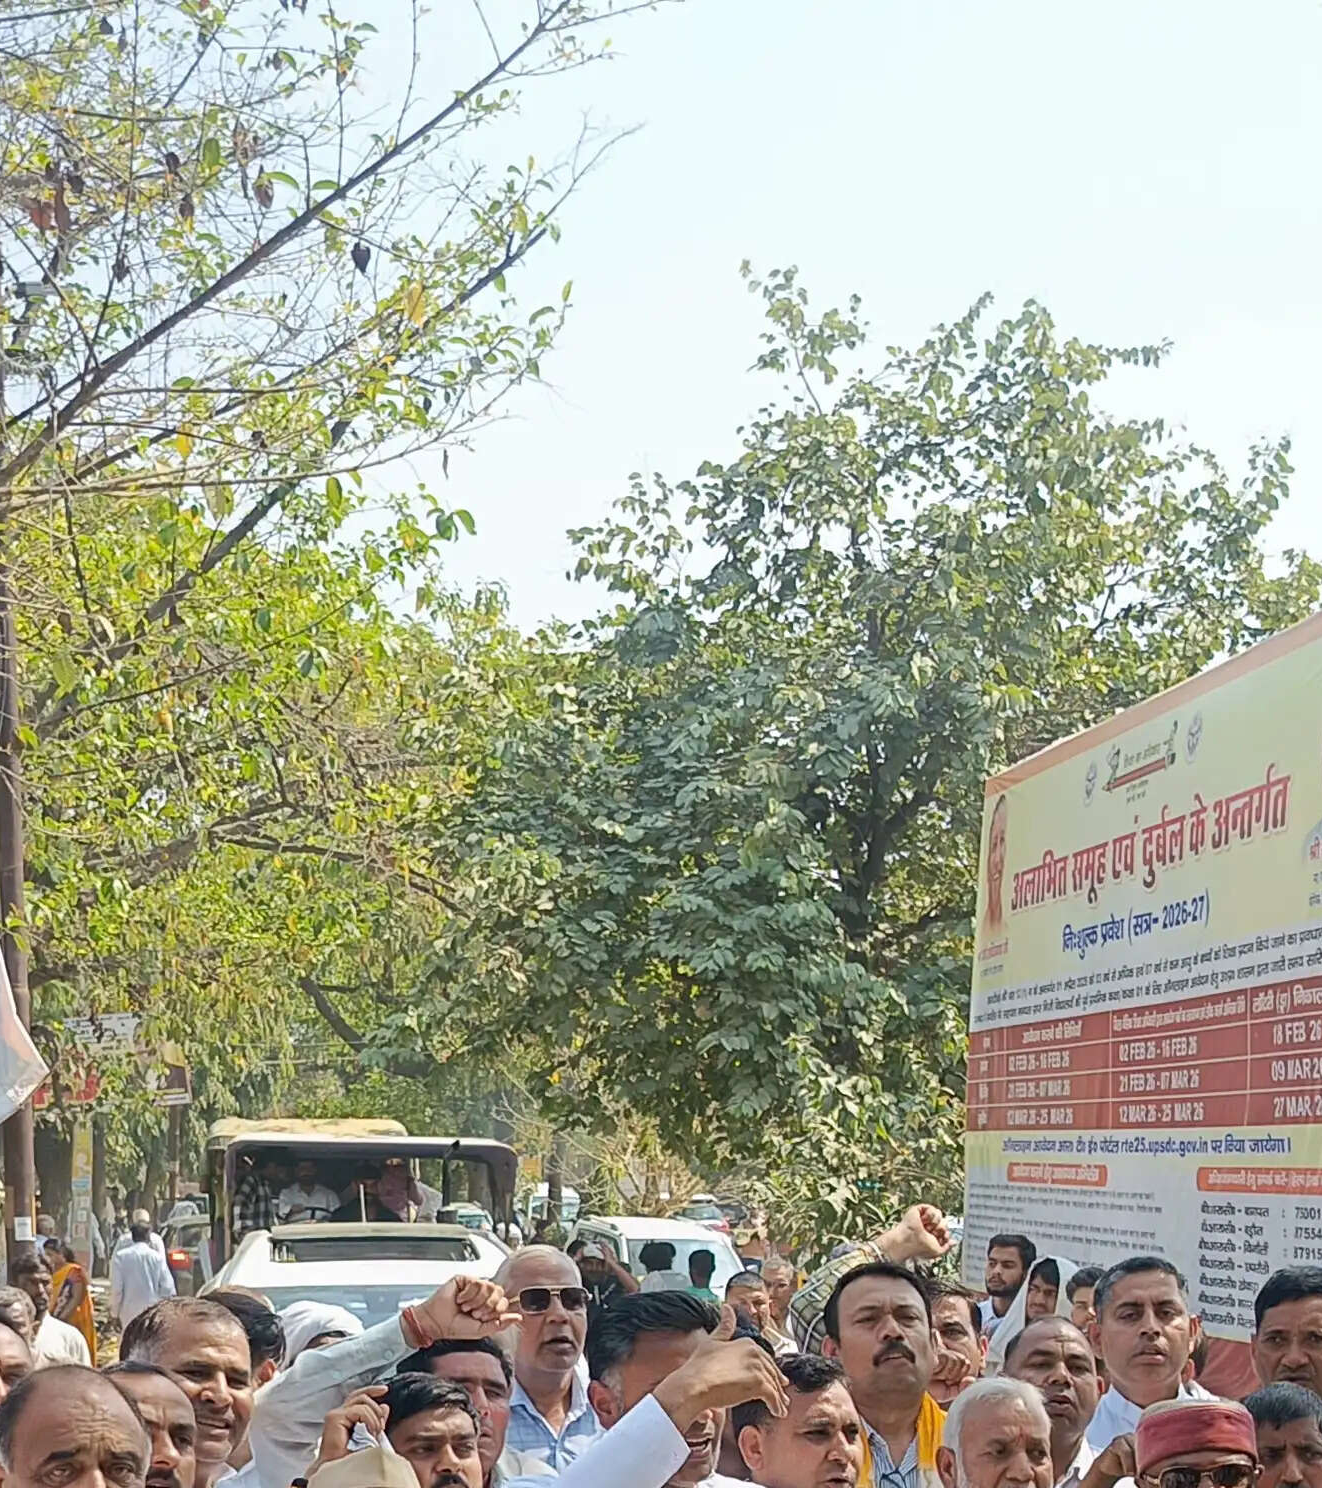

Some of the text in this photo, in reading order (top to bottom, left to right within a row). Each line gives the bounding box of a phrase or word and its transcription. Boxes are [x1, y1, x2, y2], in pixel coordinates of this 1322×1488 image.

[1011, 849, 1068, 910] अलाभित
[1072, 841, 1109, 904] समूह
[1111, 815, 1138, 880] एवं
[1142, 804, 1186, 888] दुर्बल
[1189, 793, 1207, 856] के
[1212, 763, 1291, 849] अन्तर्गत
[1101, 913, 1125, 947] प्रवेश
[1285, 1021, 1306, 1043] FEB
[1286, 1096, 1313, 1117] MAR
